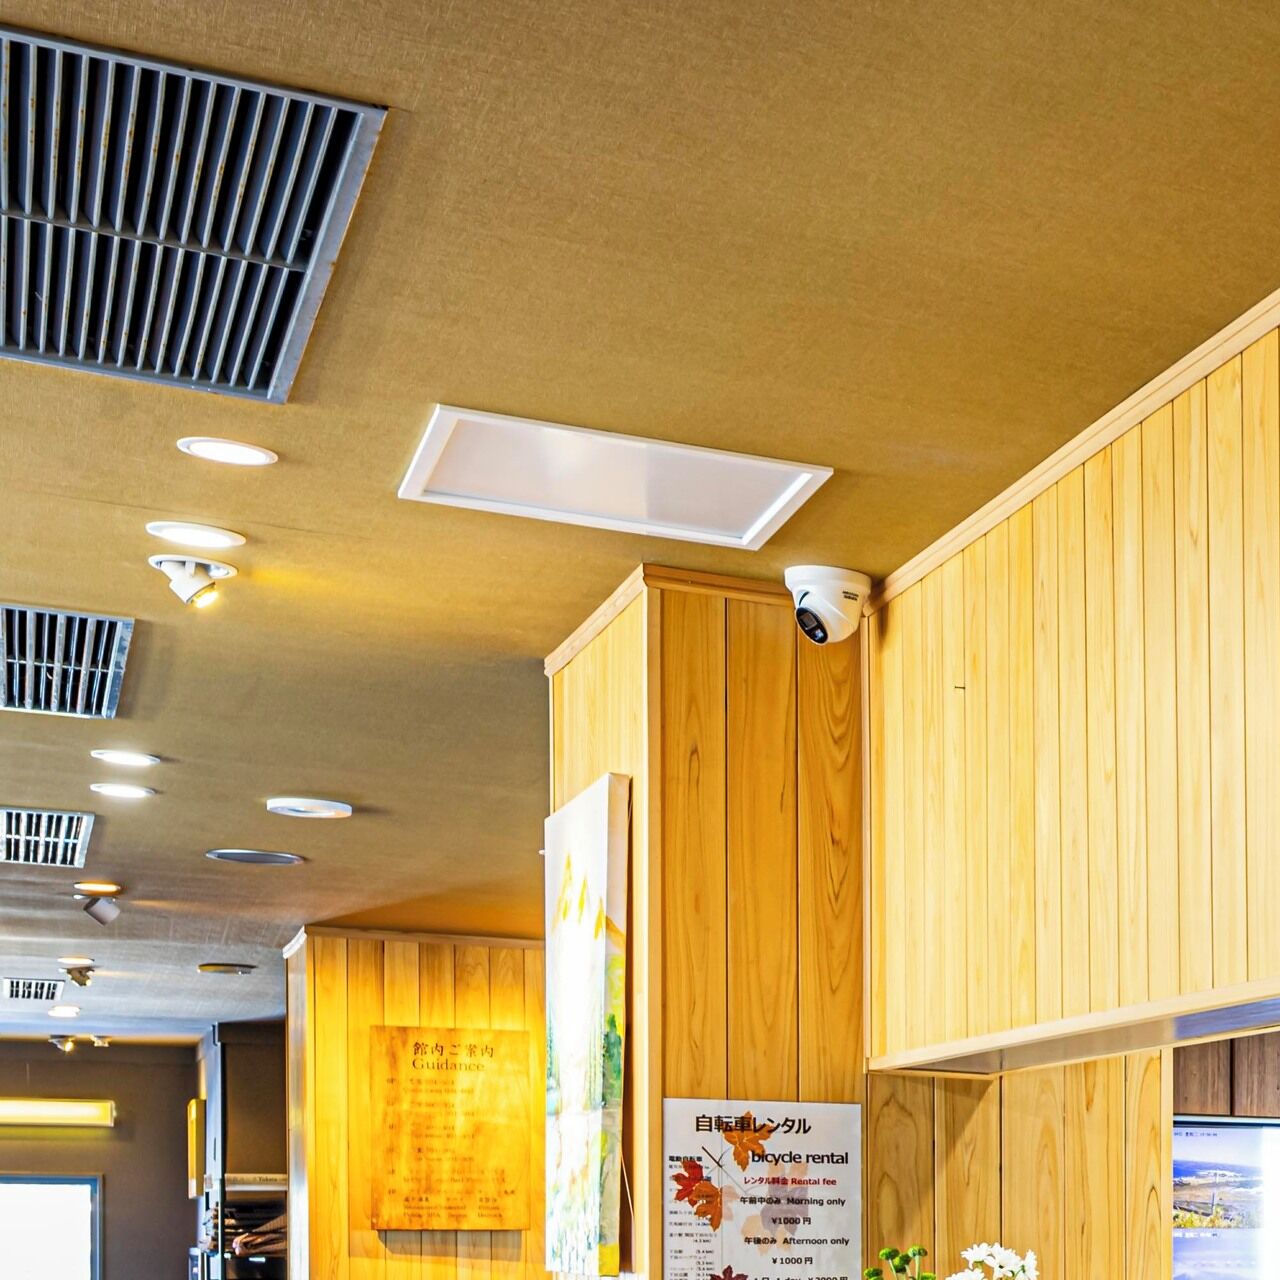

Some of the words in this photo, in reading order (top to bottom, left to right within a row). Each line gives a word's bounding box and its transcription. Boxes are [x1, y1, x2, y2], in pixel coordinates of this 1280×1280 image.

[412, 1058, 486, 1072] Guidance
[695, 1114, 812, 1134] 自転車レンタル
[752, 1151, 802, 1166] bicycle
[806, 1152, 849, 1165] rental
[791, 1177, 820, 1186] Rental
[823, 1177, 837, 1186] fee
[787, 1197, 824, 1207] Morning
[827, 1197, 846, 1207] only
[782, 1237, 828, 1245] Afternoon
[830, 1237, 850, 1246] only
